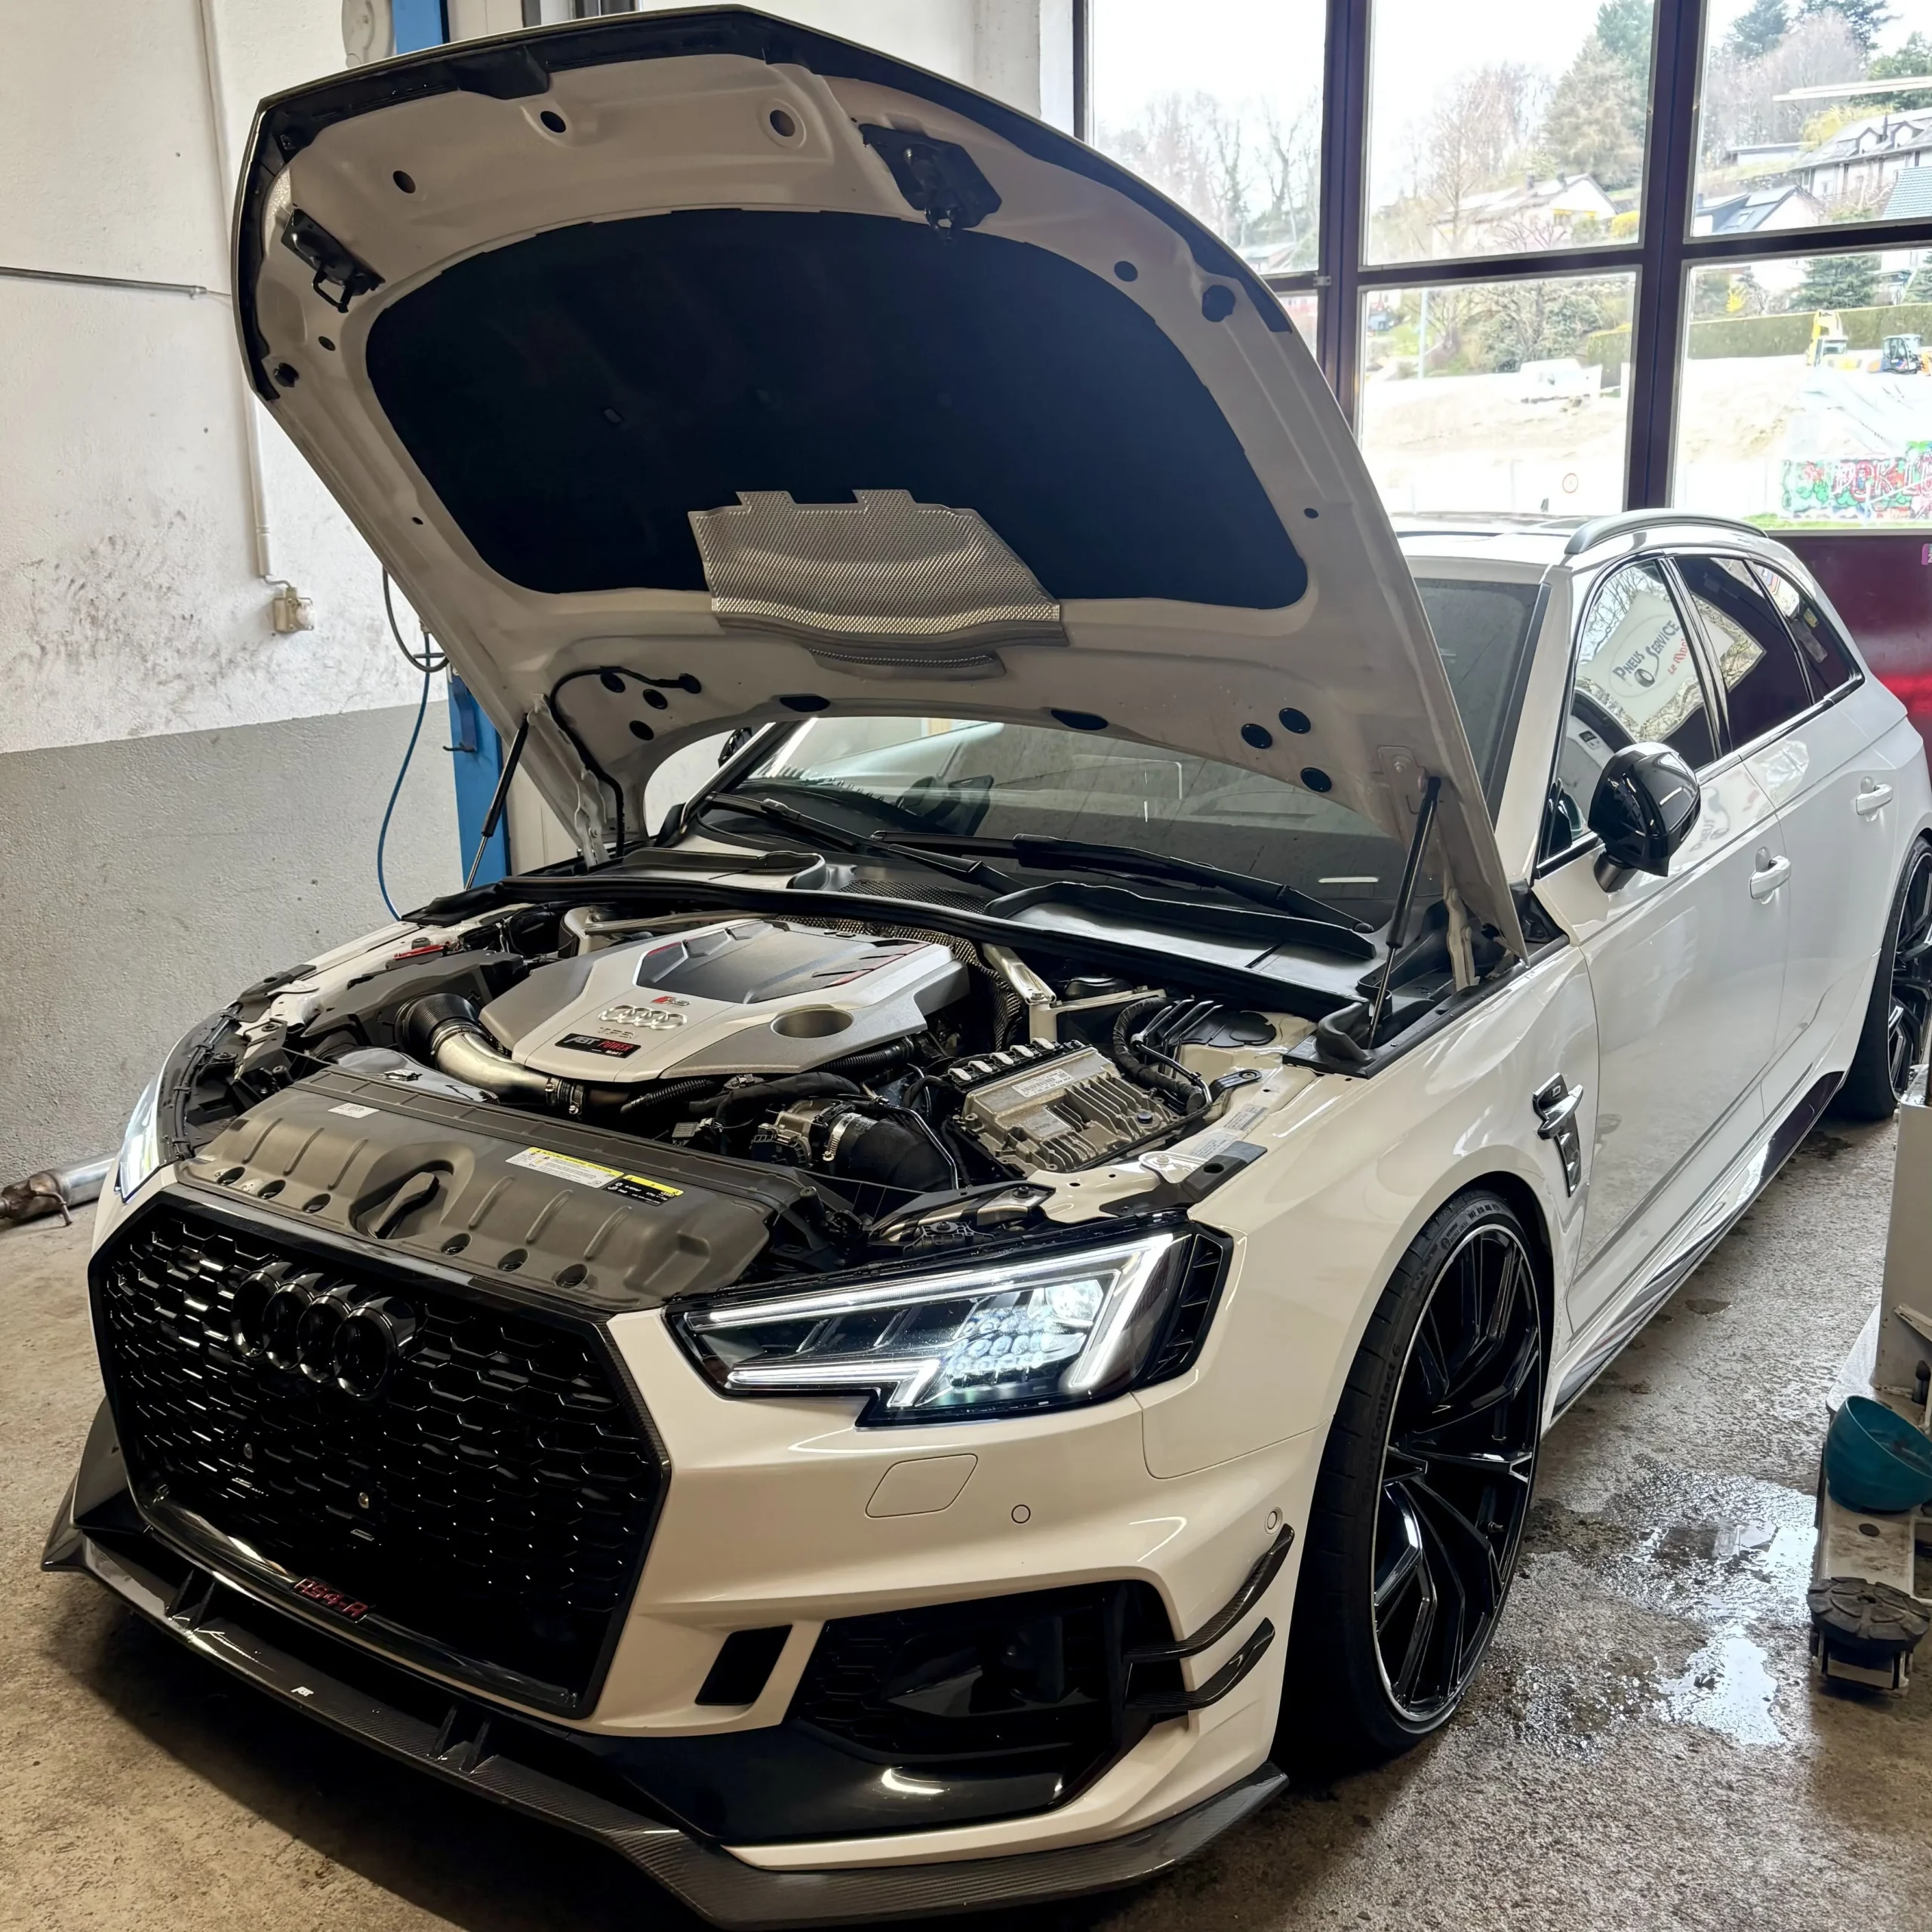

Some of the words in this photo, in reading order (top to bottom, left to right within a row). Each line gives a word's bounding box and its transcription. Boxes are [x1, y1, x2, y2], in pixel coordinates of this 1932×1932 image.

[1645, 620, 1680, 673] SERVICE
[563, 1035, 601, 1046] ABT
[597, 1039, 634, 1052] POWER
